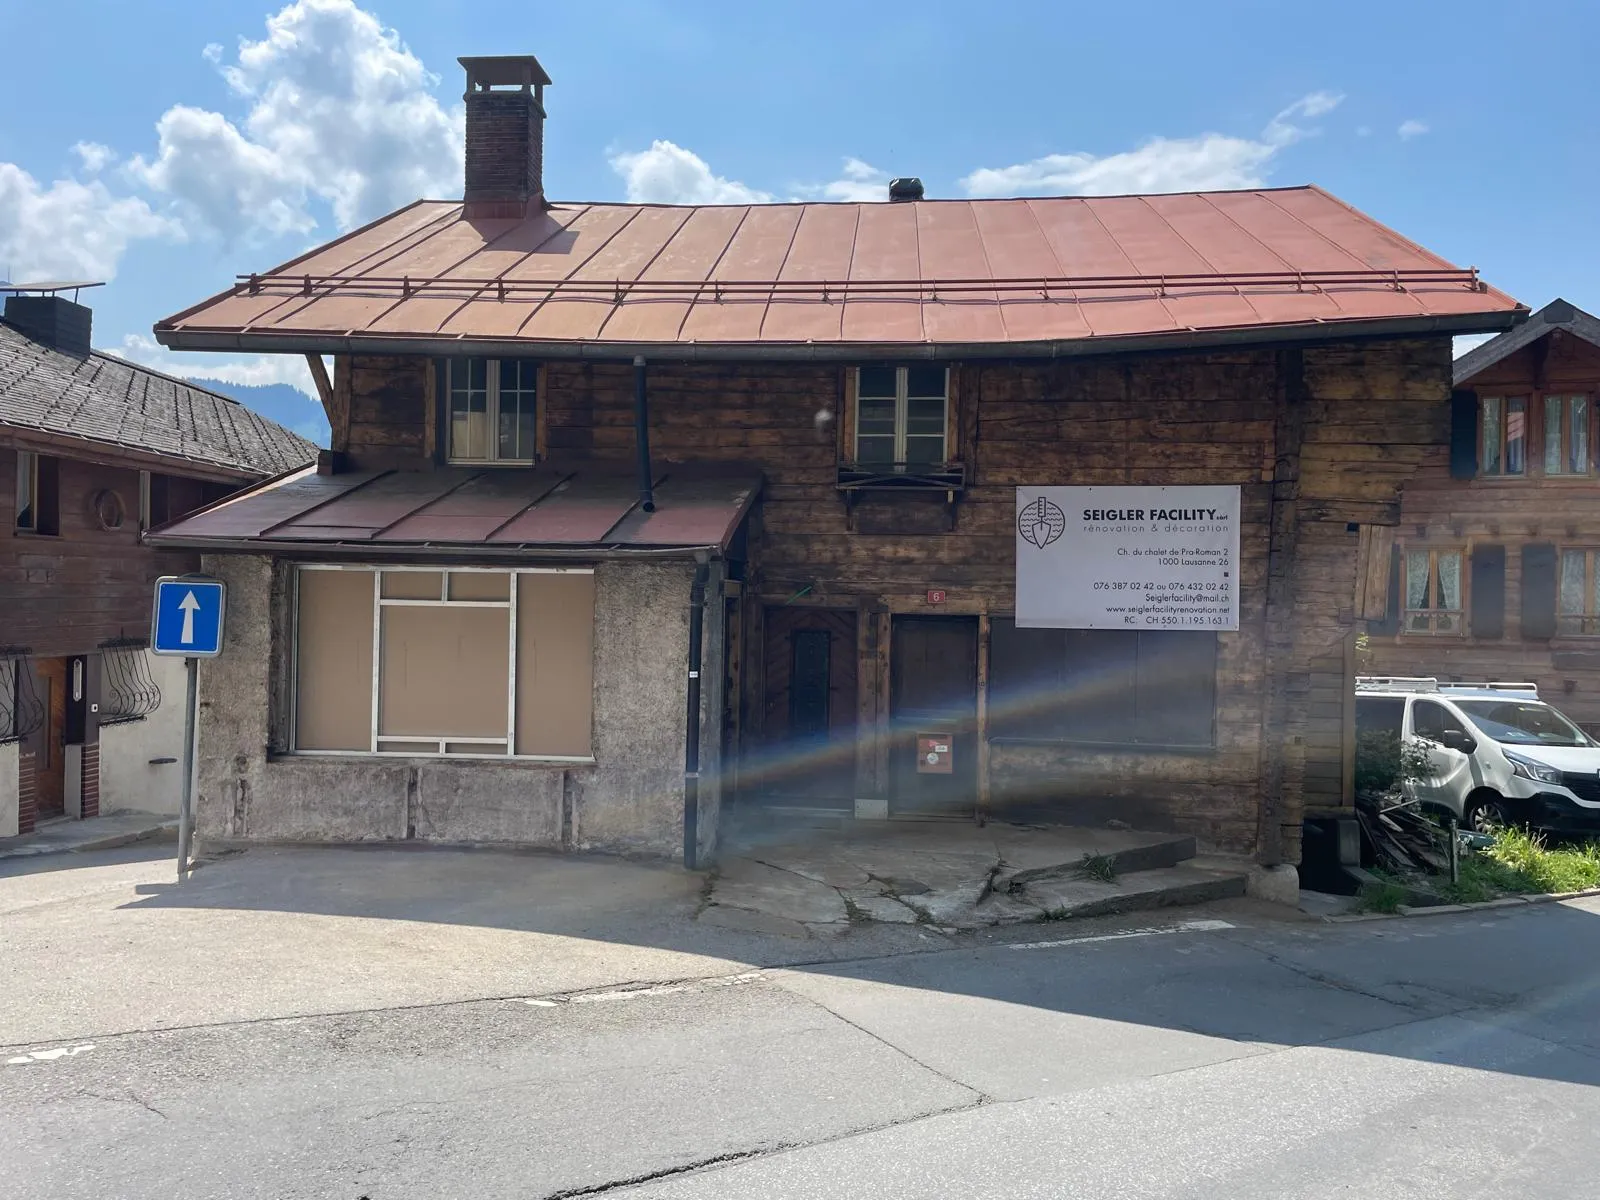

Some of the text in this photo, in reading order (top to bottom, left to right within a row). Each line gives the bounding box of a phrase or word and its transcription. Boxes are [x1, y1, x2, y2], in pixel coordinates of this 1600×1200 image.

[1083, 509, 1145, 521] SEIGLER
[1150, 509, 1216, 521] FACILITY
[1083, 523, 1229, 533] rénovation & décoration
[1117, 548, 1130, 556] Ch.
[1133, 548, 1142, 556] du
[1144, 548, 1167, 556] chalet
[1169, 548, 1179, 556] de
[1223, 548, 1229, 556] 2
[1158, 557, 1229, 566] 1000 Lausanne 26
[1093, 582, 1109, 590] 076
[1112, 582, 1128, 590] 387
[1130, 582, 1141, 590] 02
[1168, 582, 1185, 590] 076
[1187, 583, 1203, 591] 432
[1206, 583, 1217, 591] 02
[1219, 583, 1229, 591] 42
[1145, 593, 1229, 604] Seiglerfacility@mail.ch
[1106, 605, 1230, 615] www.seiglerfacilityrenovation.net
